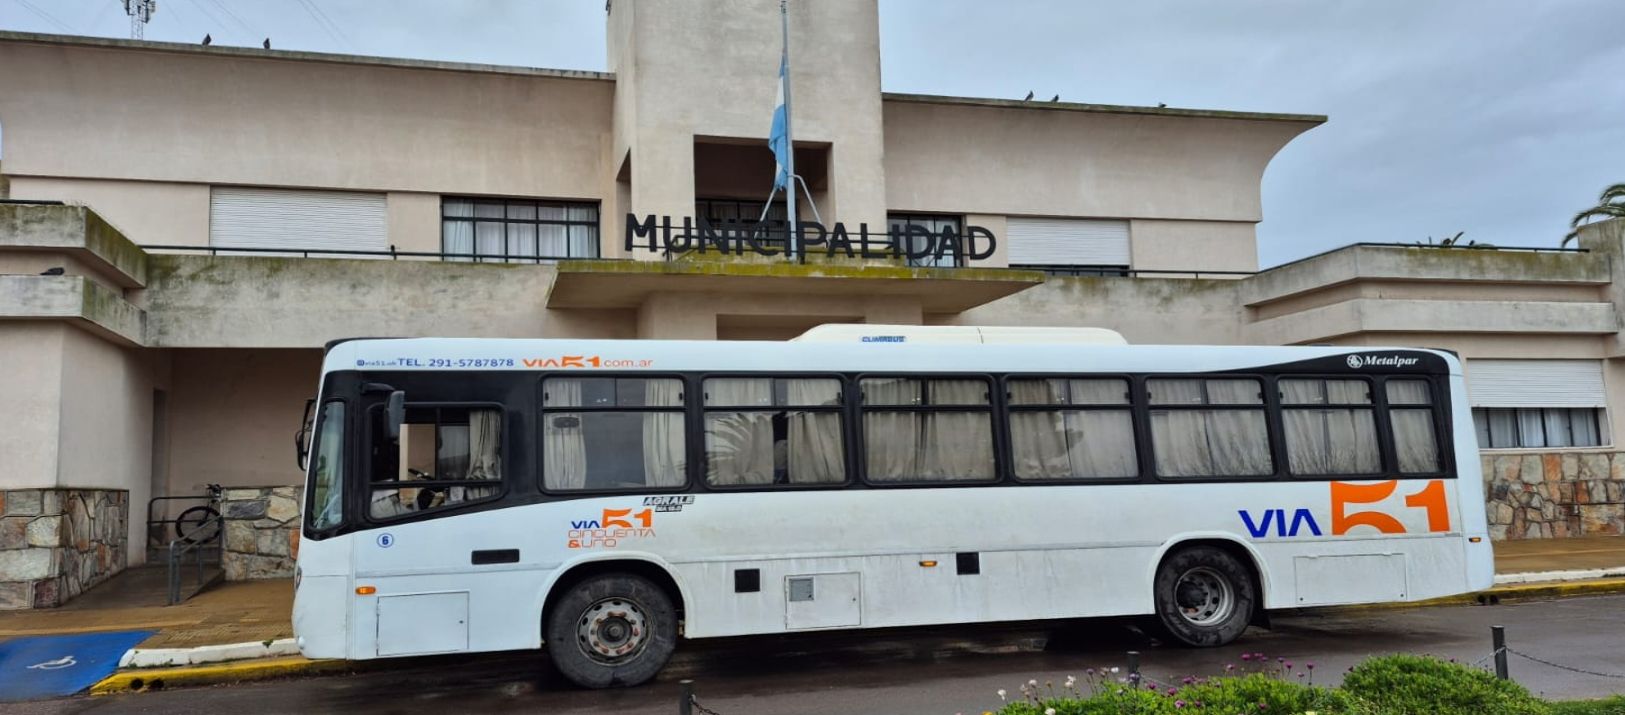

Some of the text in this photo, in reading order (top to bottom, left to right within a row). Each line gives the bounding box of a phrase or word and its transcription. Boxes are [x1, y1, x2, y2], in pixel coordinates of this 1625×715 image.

[624, 212, 997, 261] MUNICIPALIDAD
[398, 358, 514, 368] TEL. 291-5787878
[1364, 355, 1419, 368] Metalpar
[643, 496, 695, 506] AGRALE
[1237, 480, 1451, 539] VIA 51
[568, 529, 656, 538] CINCUENTA
